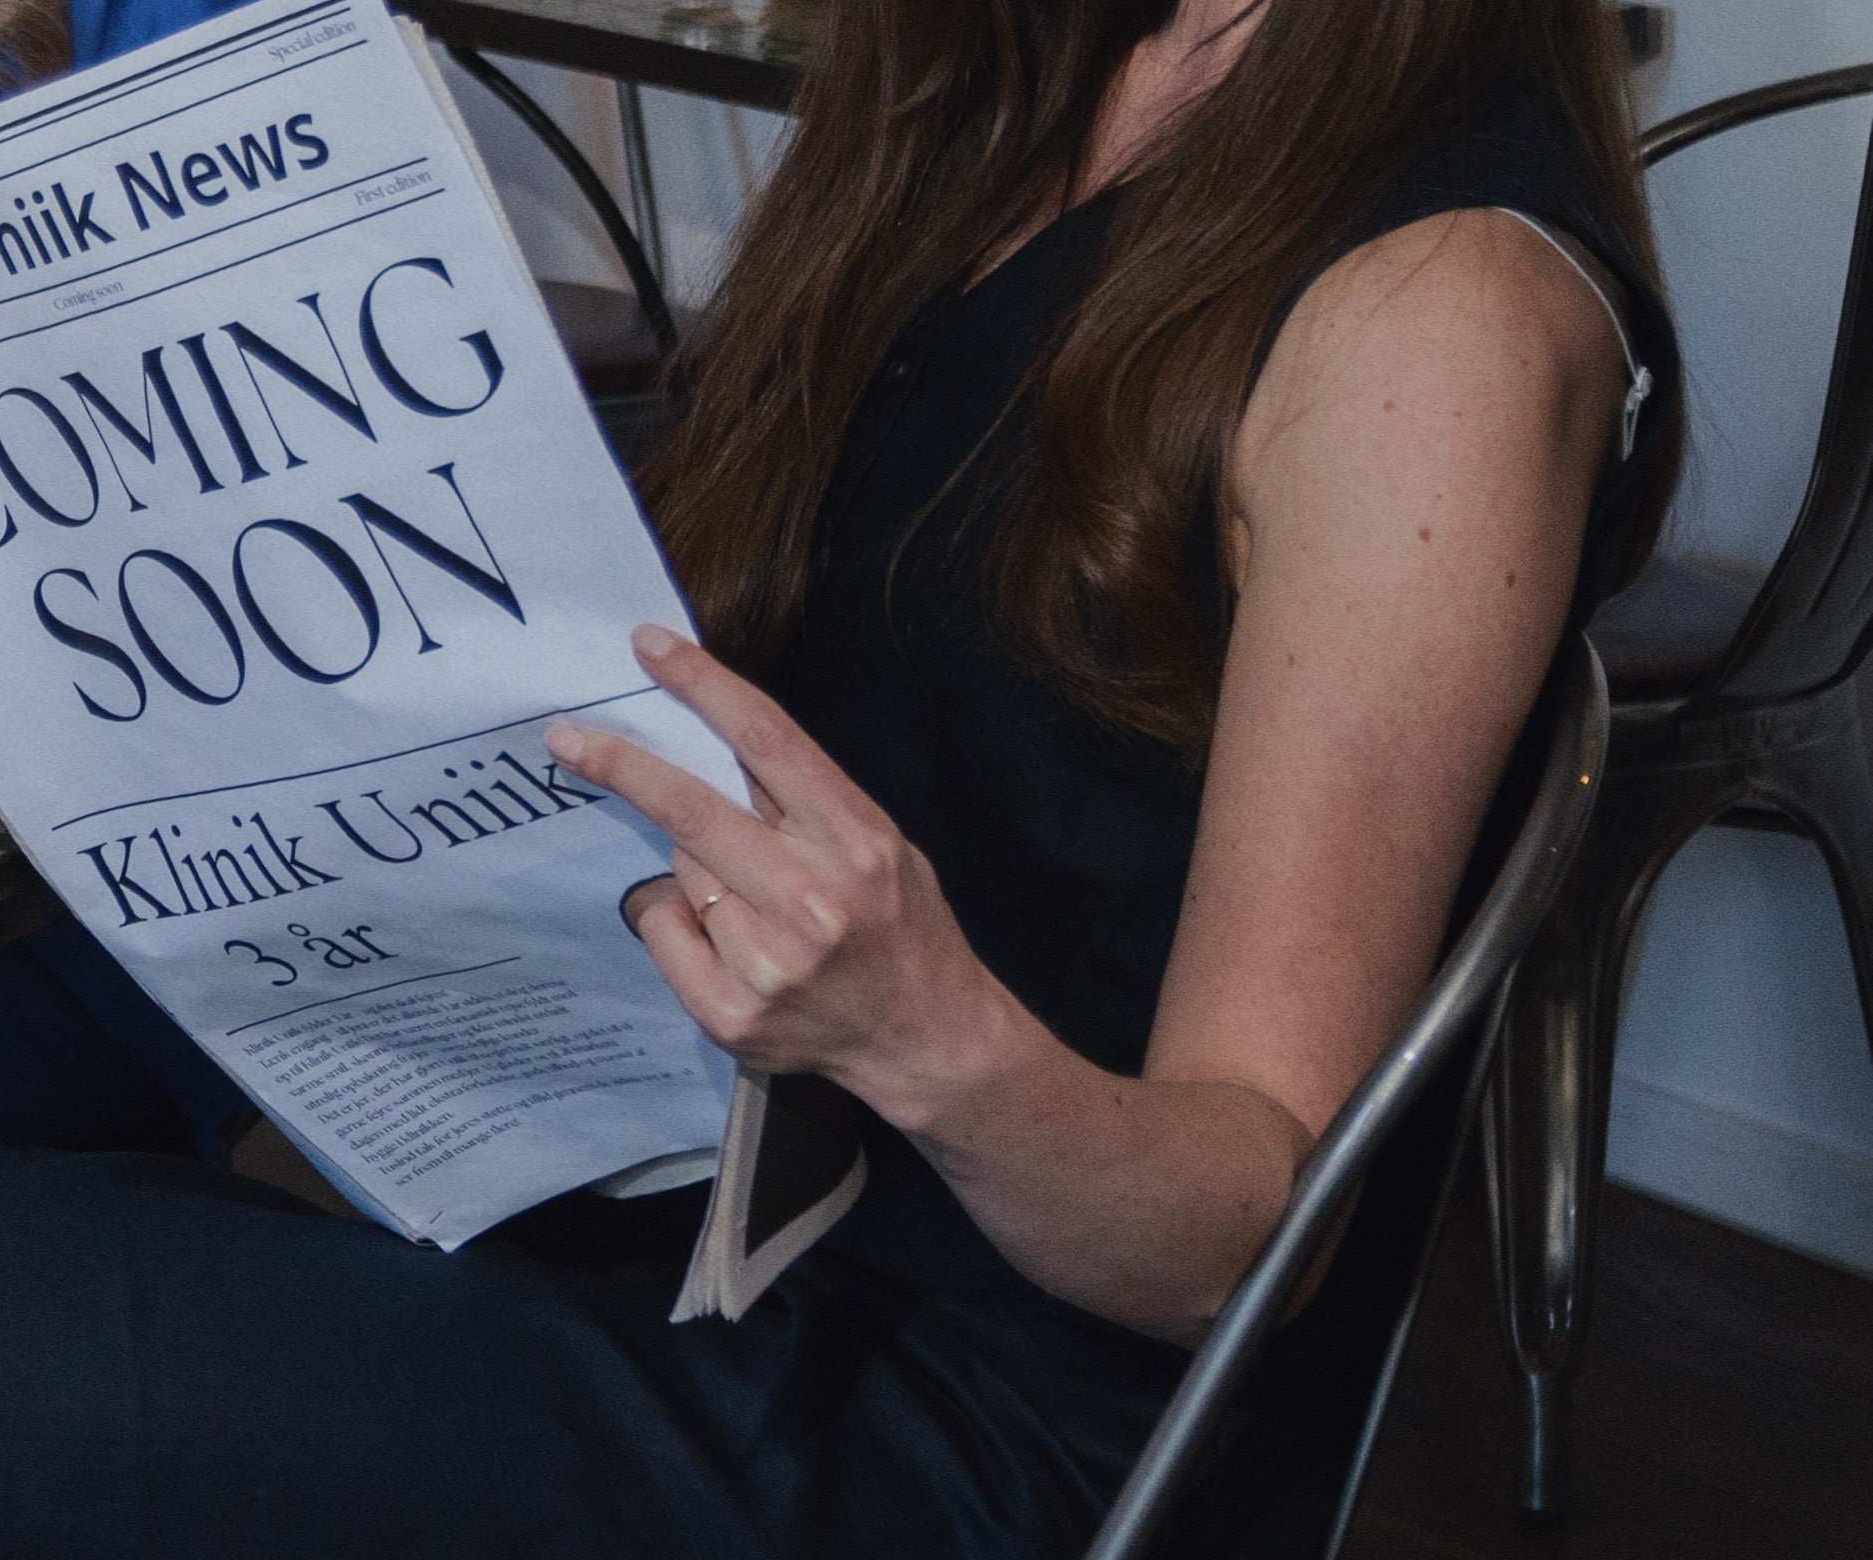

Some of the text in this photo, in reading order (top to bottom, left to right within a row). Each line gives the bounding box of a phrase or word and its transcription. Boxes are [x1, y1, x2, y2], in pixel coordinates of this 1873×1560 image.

[268, 22, 358, 63] Special edition
[114, 112, 329, 231] News
[354, 171, 432, 205] First edition
[53, 282, 124, 311] Coming soon
[32, 461, 526, 722] SOON
[77, 750, 608, 928] Klinik Uniik
[223, 918, 399, 987] 3 år
[394, 1117, 522, 1186] ser frem til mange flere!
